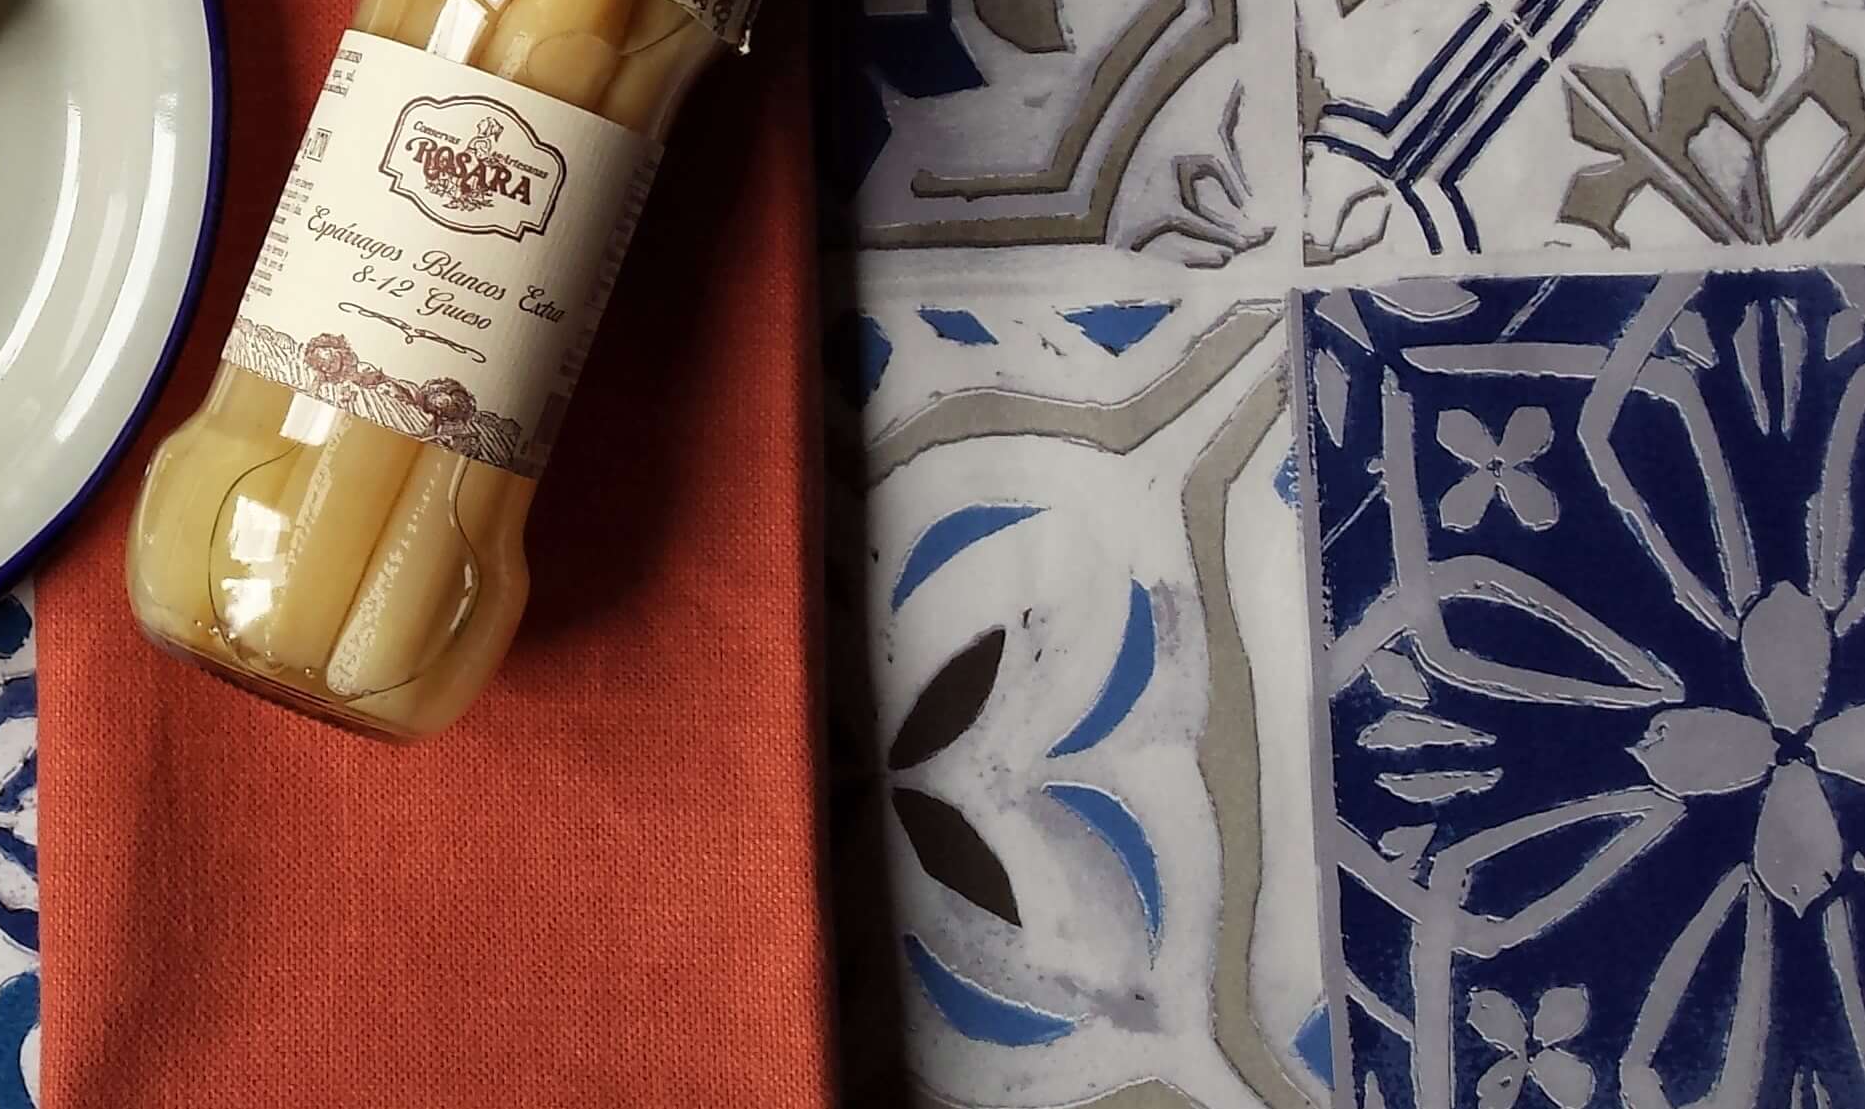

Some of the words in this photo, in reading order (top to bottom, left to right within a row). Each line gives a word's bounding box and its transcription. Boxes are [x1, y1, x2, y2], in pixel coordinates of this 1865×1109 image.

[413, 120, 462, 146] Conservas
[405, 136, 531, 206] ROSARA
[352, 265, 415, 298] 8-12
[416, 287, 492, 330] Grueso
[412, 250, 507, 301] Blancos
[518, 284, 566, 324] Extra
